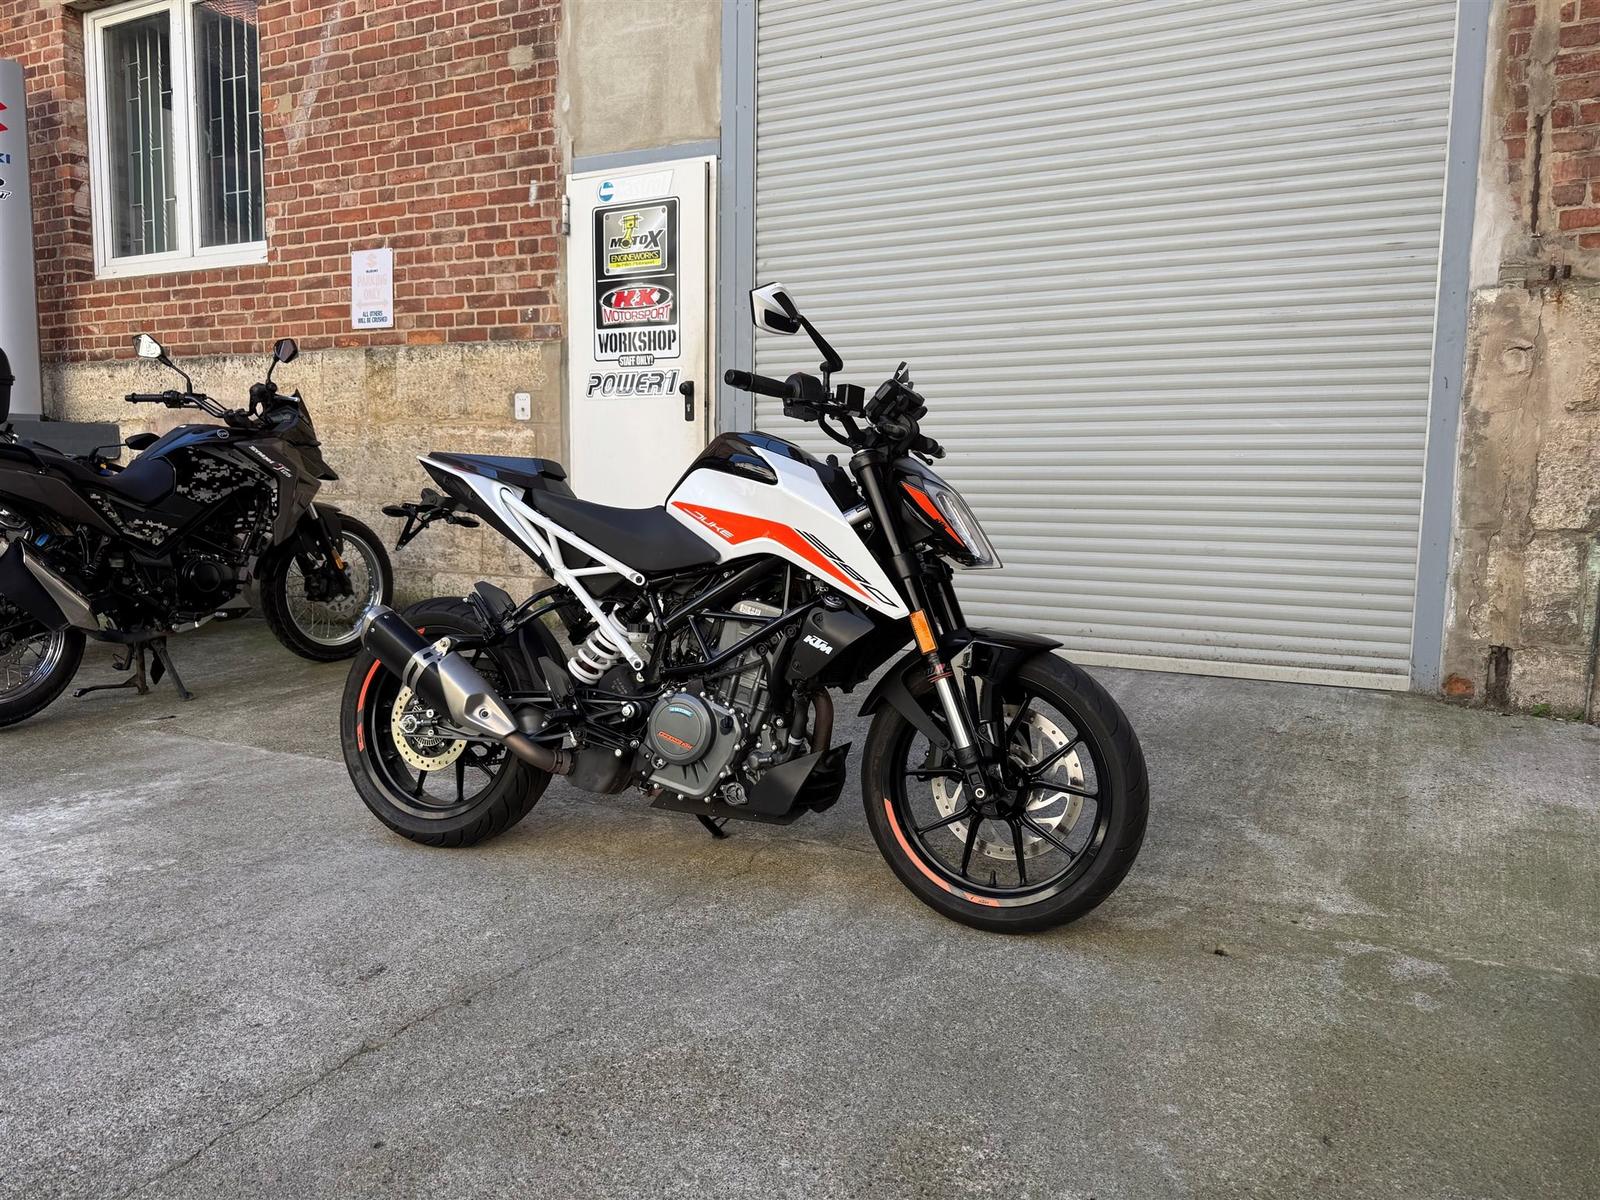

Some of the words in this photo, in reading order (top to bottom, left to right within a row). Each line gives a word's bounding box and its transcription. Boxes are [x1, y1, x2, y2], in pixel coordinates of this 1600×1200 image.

[611, 251, 660, 263] ENGINEWORKS
[603, 304, 672, 322] MOTORSPORT
[598, 329, 677, 354] WORKSHOP
[619, 355, 636, 366] STAFF
[636, 354, 654, 365] ONLY!
[587, 370, 679, 397] POWER1
[683, 507, 735, 539] DUKE
[803, 635, 833, 654] KTM
